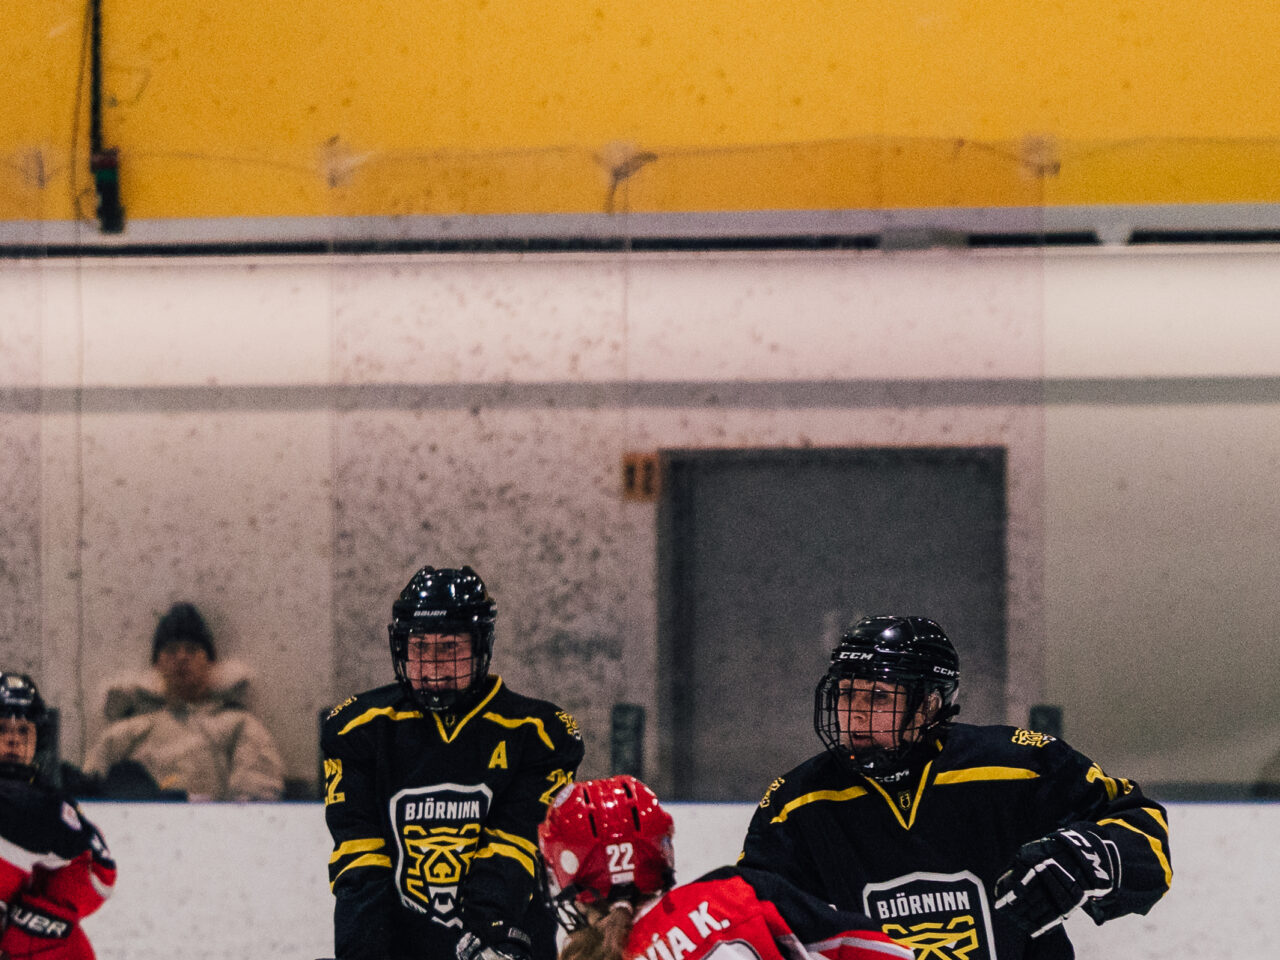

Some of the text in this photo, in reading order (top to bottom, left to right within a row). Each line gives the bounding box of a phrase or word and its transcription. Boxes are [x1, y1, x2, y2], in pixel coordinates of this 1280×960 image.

[839, 651, 874, 661] CCM
[933, 665, 956, 677] CCM
[487, 740, 508, 769] A
[404, 797, 480, 821] BJÖRNINN
[606, 842, 635, 872] 22
[1057, 828, 1111, 881] CM
[688, 901, 731, 939] K.
[876, 891, 971, 920] BJÖRNINN
[10, 904, 68, 937] UER
